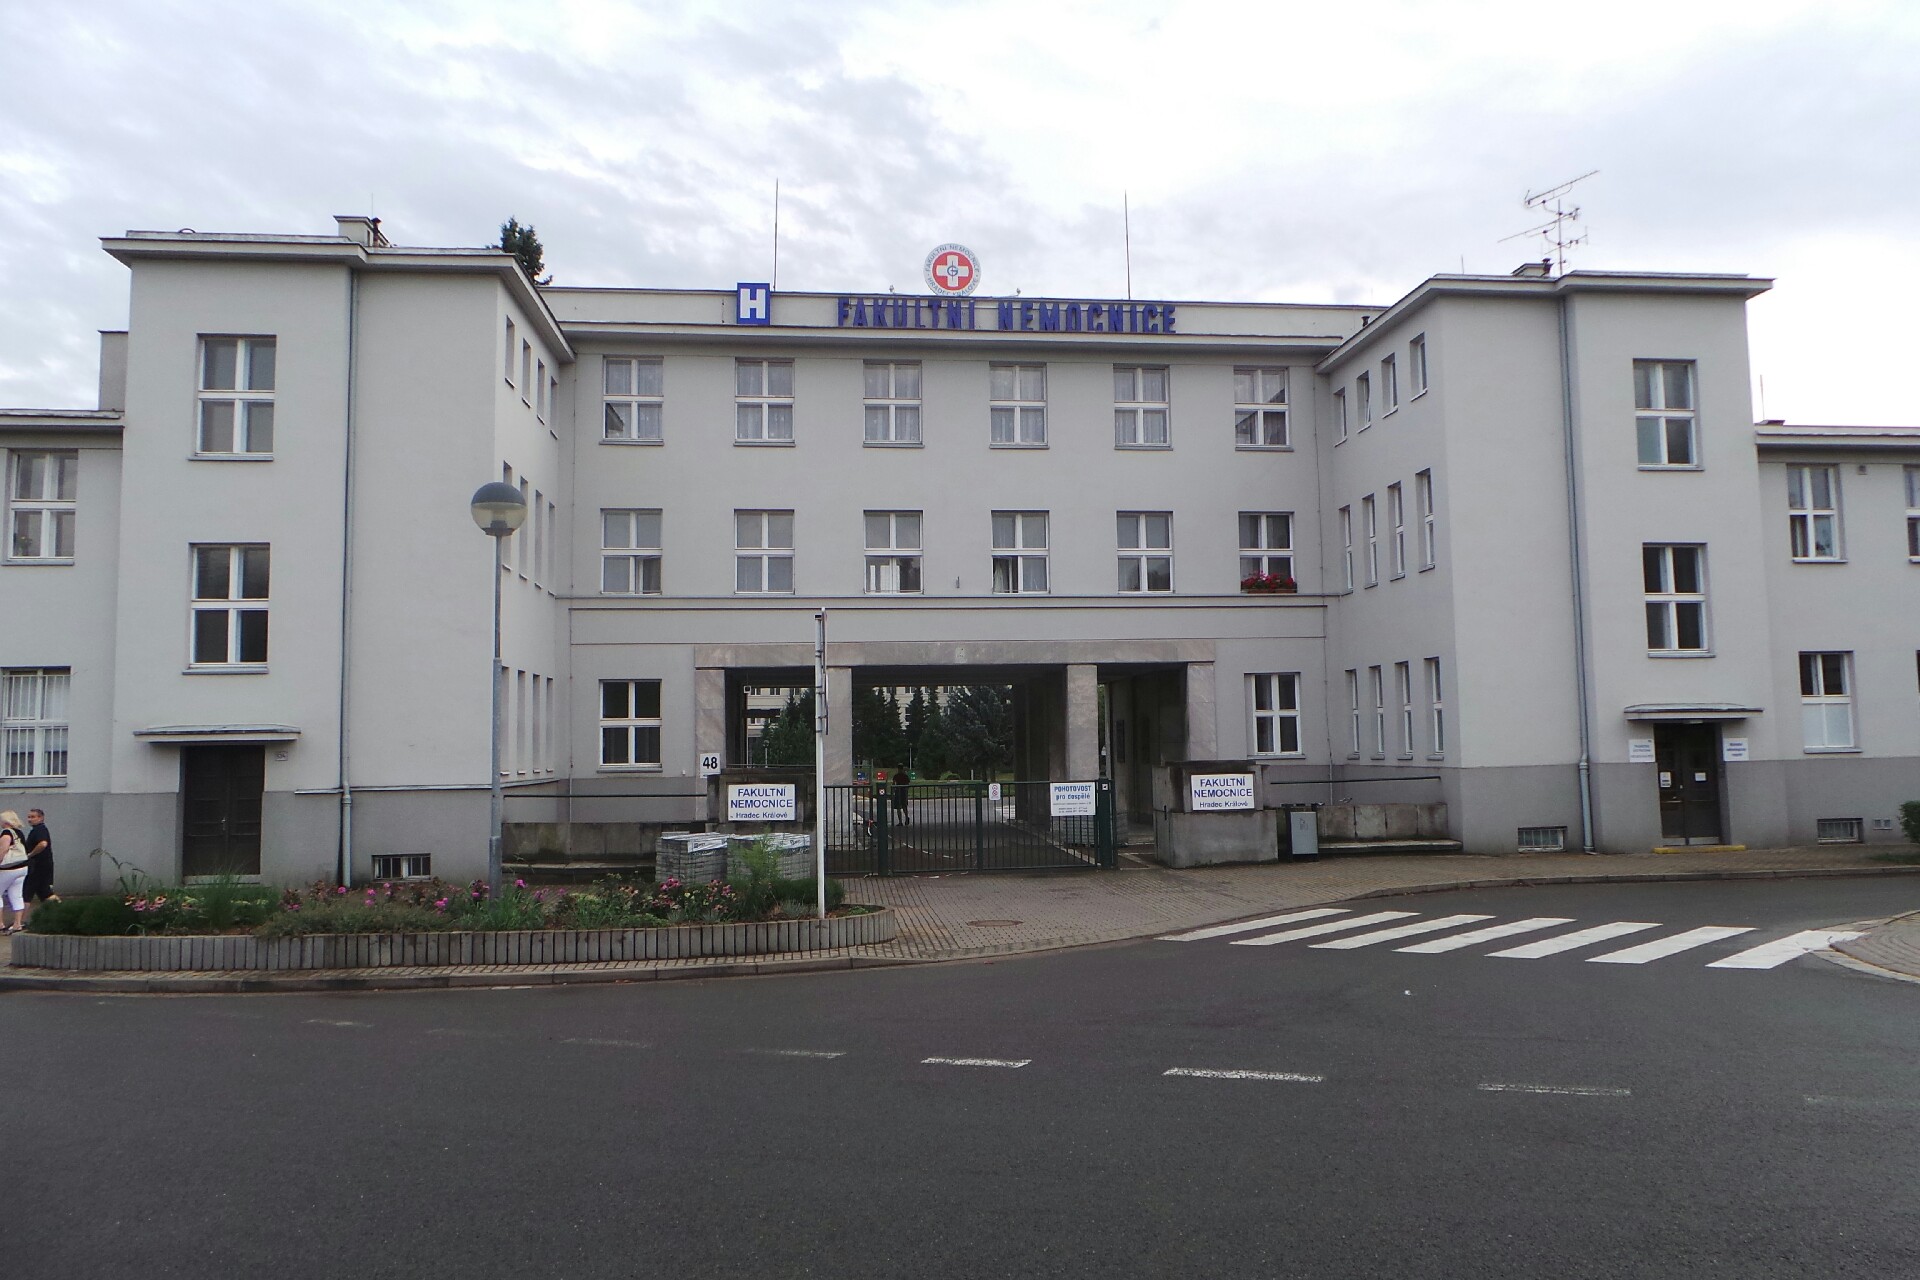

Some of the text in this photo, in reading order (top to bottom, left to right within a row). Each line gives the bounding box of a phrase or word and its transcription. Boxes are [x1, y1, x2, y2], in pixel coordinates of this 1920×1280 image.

[740, 288, 766, 319] H
[997, 301, 1177, 334] NEMOCNICE
[702, 756, 718, 770] 48
[1201, 776, 1245, 787] FAKULTNÍ
[737, 786, 787, 797] FAKULTNÍ
[1054, 785, 1092, 793] POHOTOVOST
[1194, 788, 1253, 798] NEMOCNICE
[730, 799, 794, 809] NEMOCNICE
[735, 811, 788, 819] Hradec Králové
